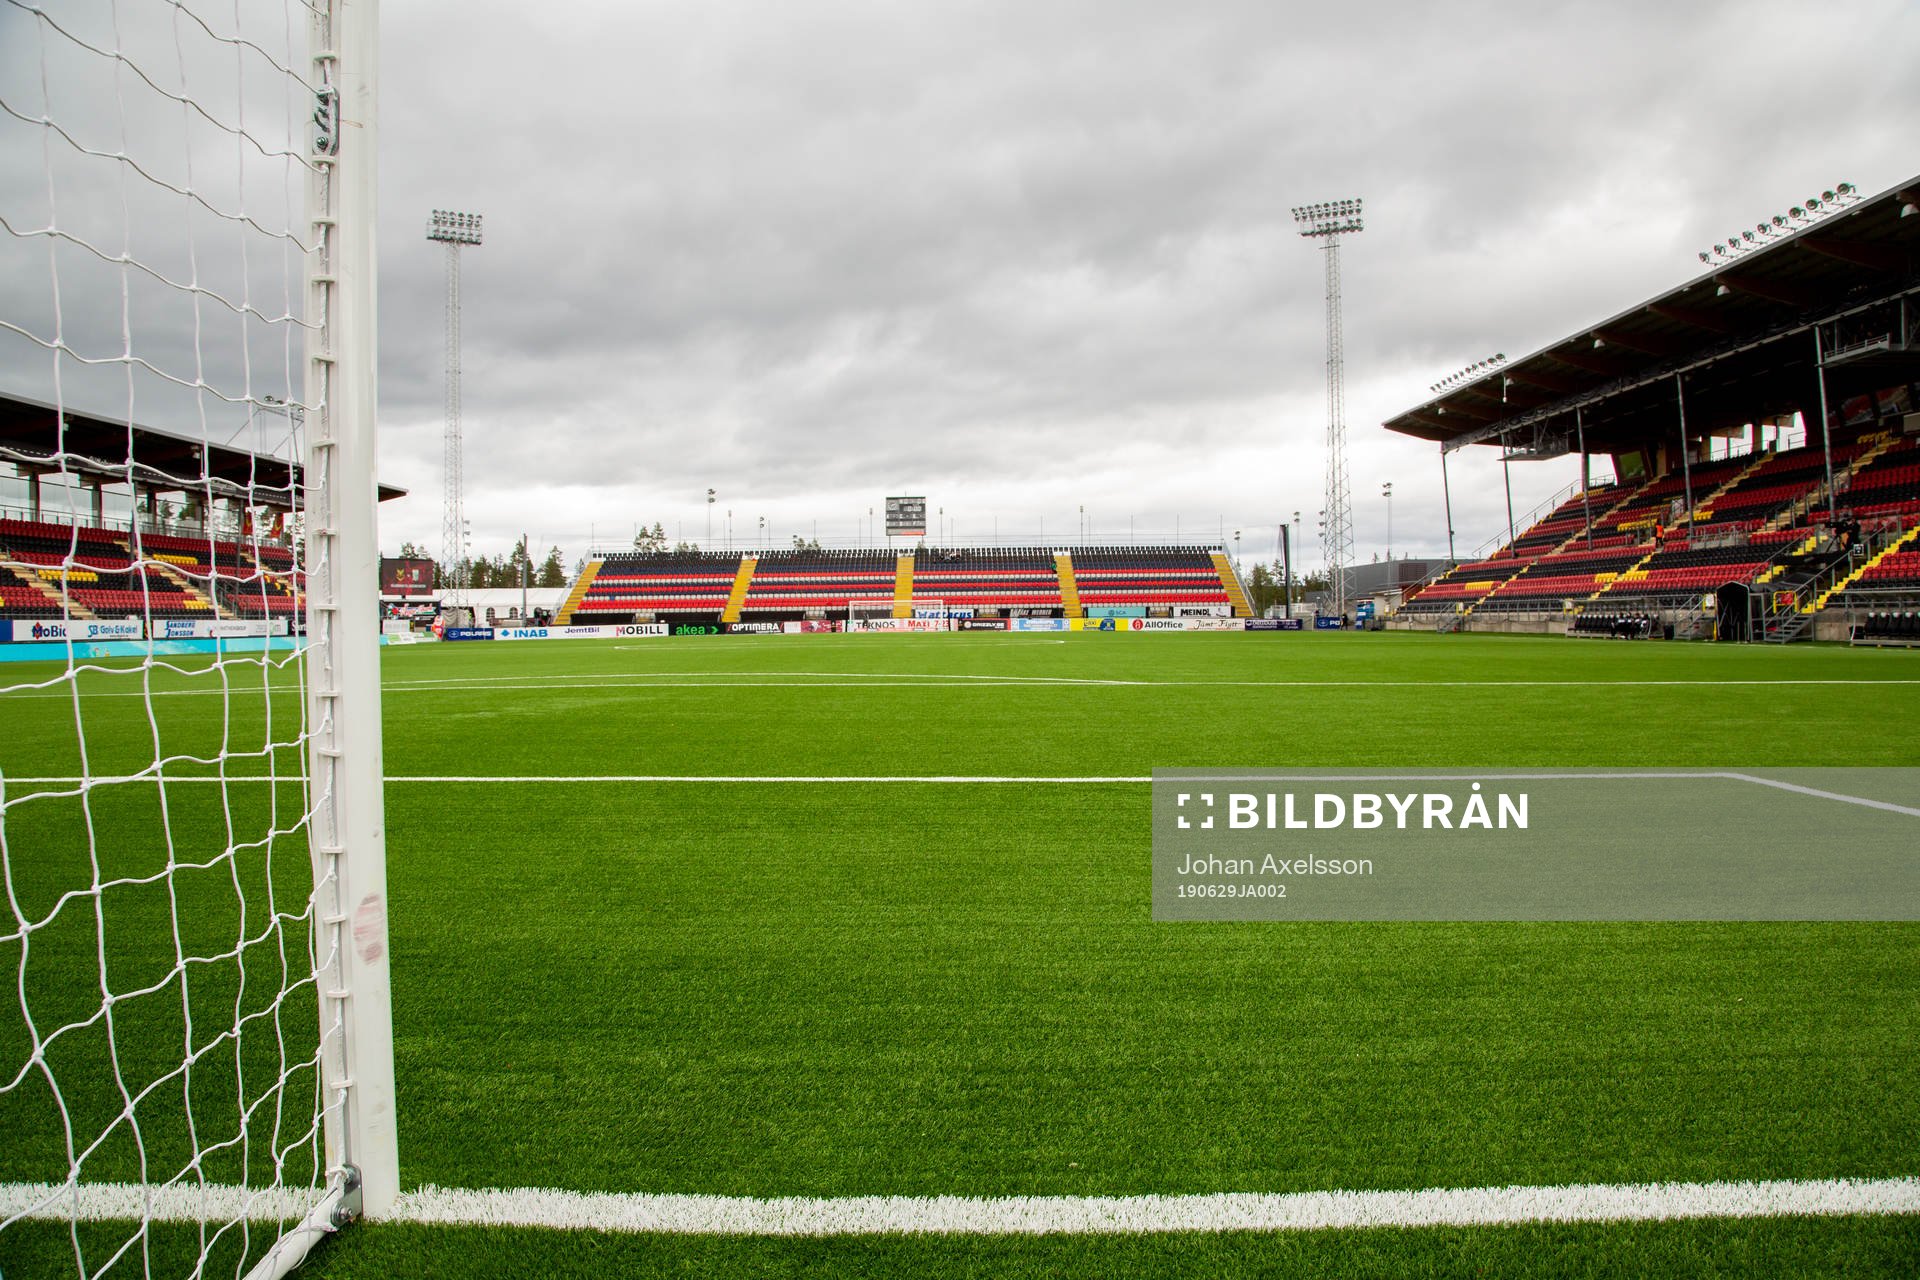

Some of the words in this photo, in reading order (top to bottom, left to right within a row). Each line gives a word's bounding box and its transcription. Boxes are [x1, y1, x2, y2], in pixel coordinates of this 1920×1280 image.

[1180, 608, 1211, 617] MEINDL
[1144, 620, 1183, 629] AllOffice
[514, 629, 548, 638] INAB
[616, 625, 663, 636] MOBILL
[675, 624, 705, 636] akea
